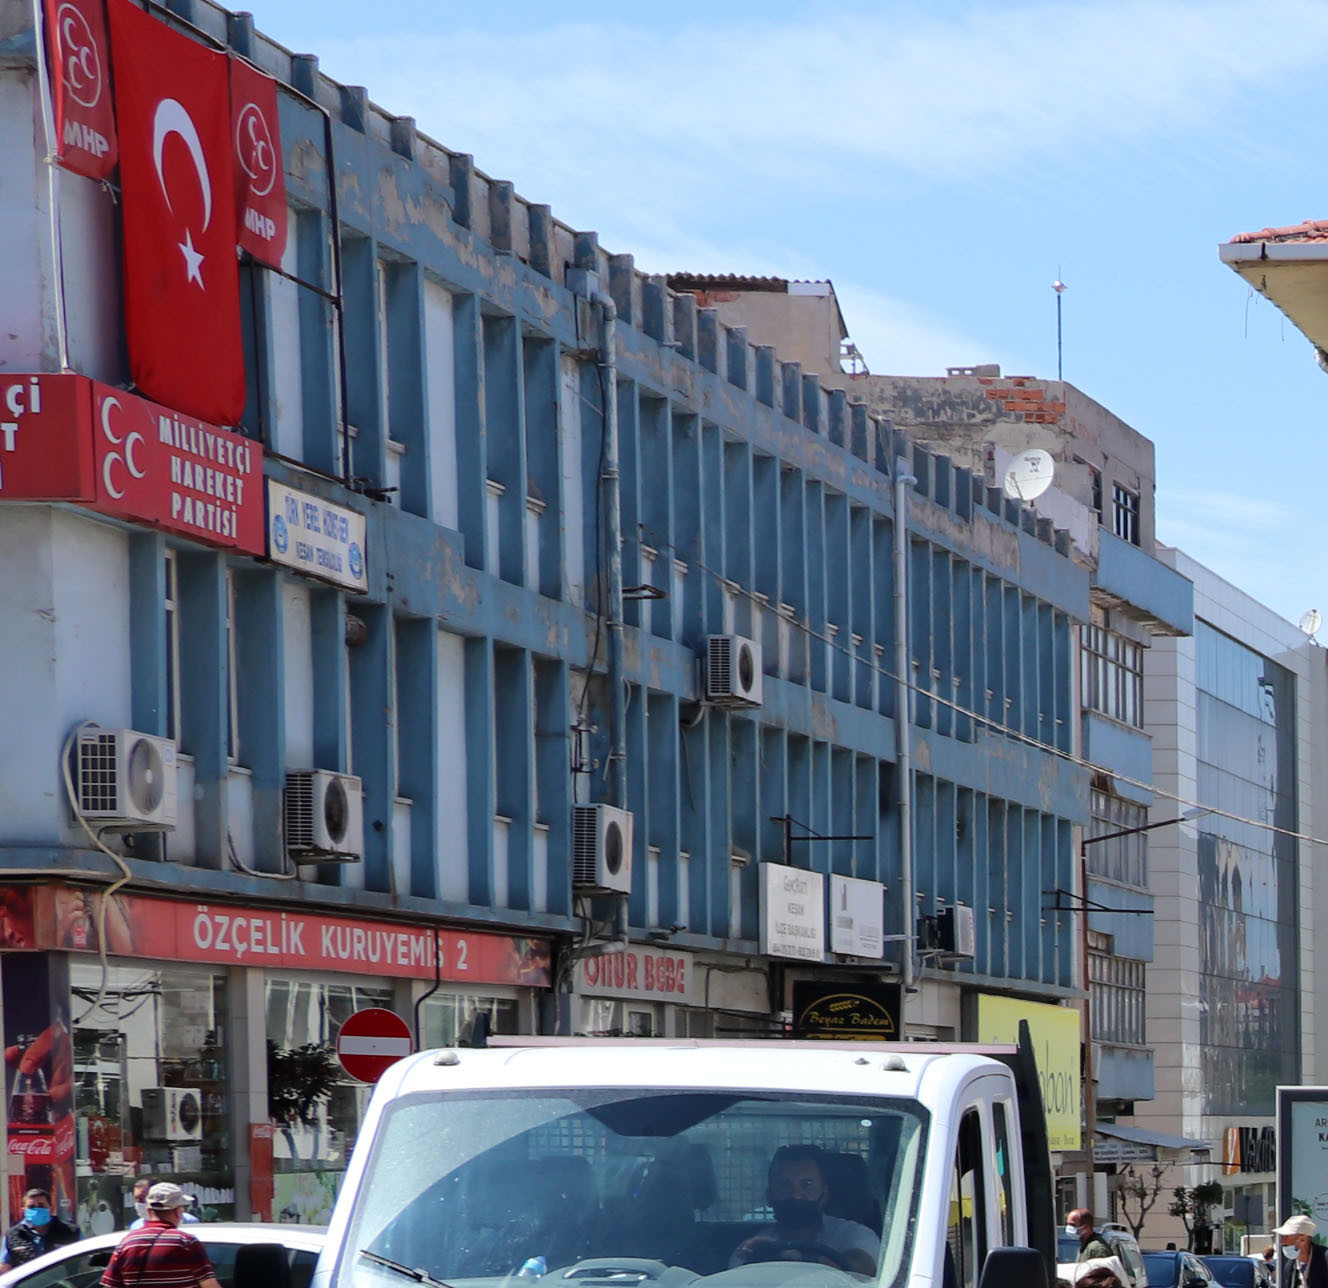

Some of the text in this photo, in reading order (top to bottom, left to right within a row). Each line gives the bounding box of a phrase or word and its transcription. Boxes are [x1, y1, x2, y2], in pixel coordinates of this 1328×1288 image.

[64, 118, 110, 158] MHP
[158, 413, 251, 475] MİLLİYETÇİ
[170, 455, 243, 506] HAREKET
[171, 491, 237, 539] PARTİSİ
[193, 904, 306, 958] ÖZÇELİK
[456, 940, 469, 971] 2
[643, 954, 685, 994] BEBE
